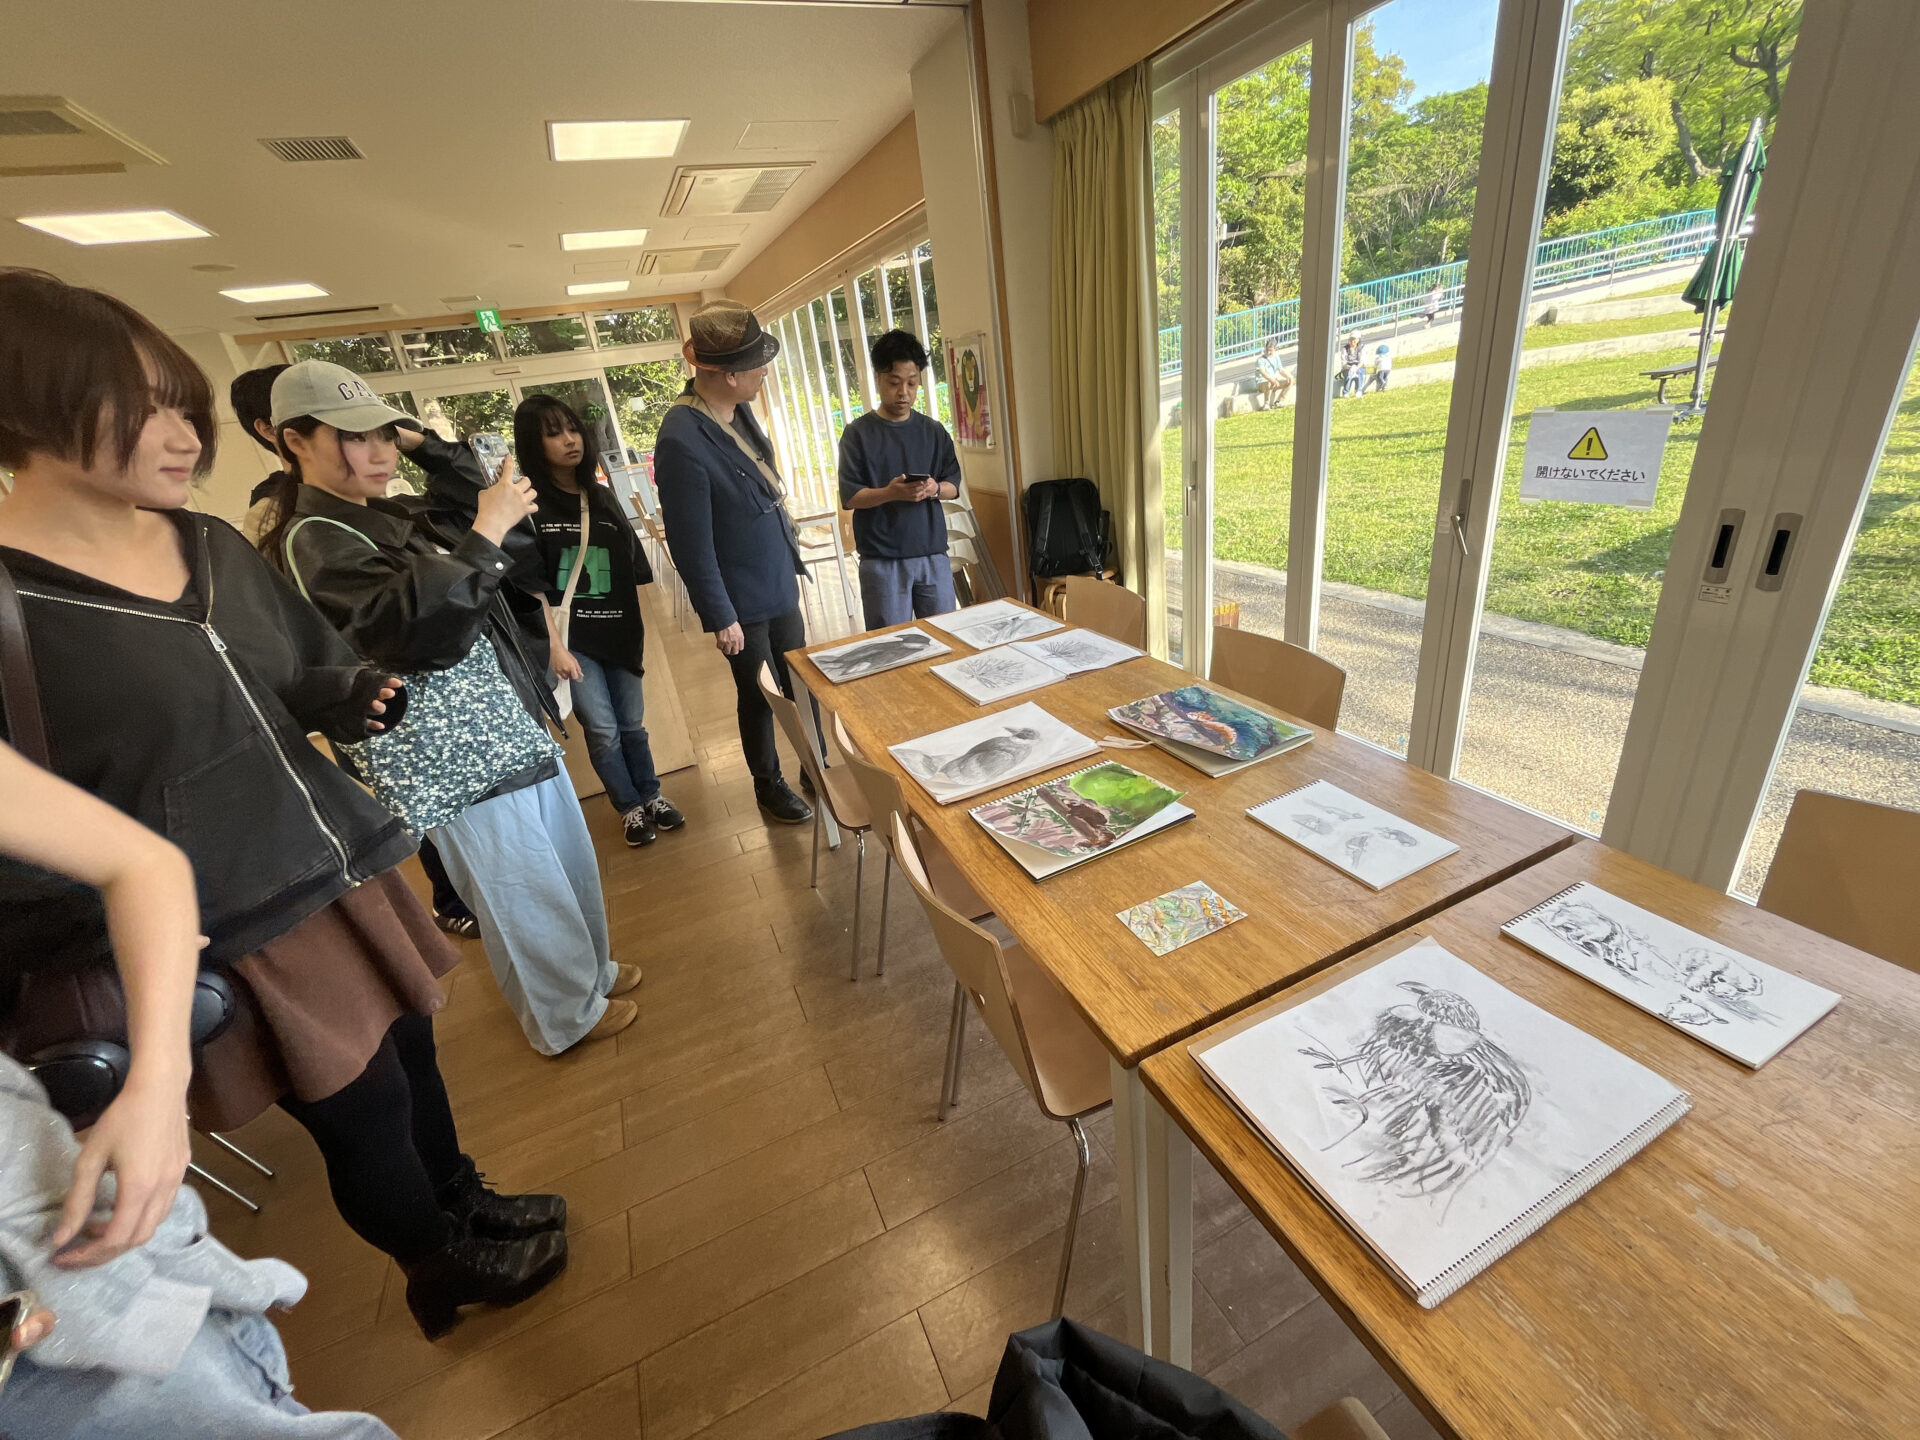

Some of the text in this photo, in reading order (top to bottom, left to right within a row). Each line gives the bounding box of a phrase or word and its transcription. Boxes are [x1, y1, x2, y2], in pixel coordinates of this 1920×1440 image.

[1535, 465, 1646, 482] 開けないでください
